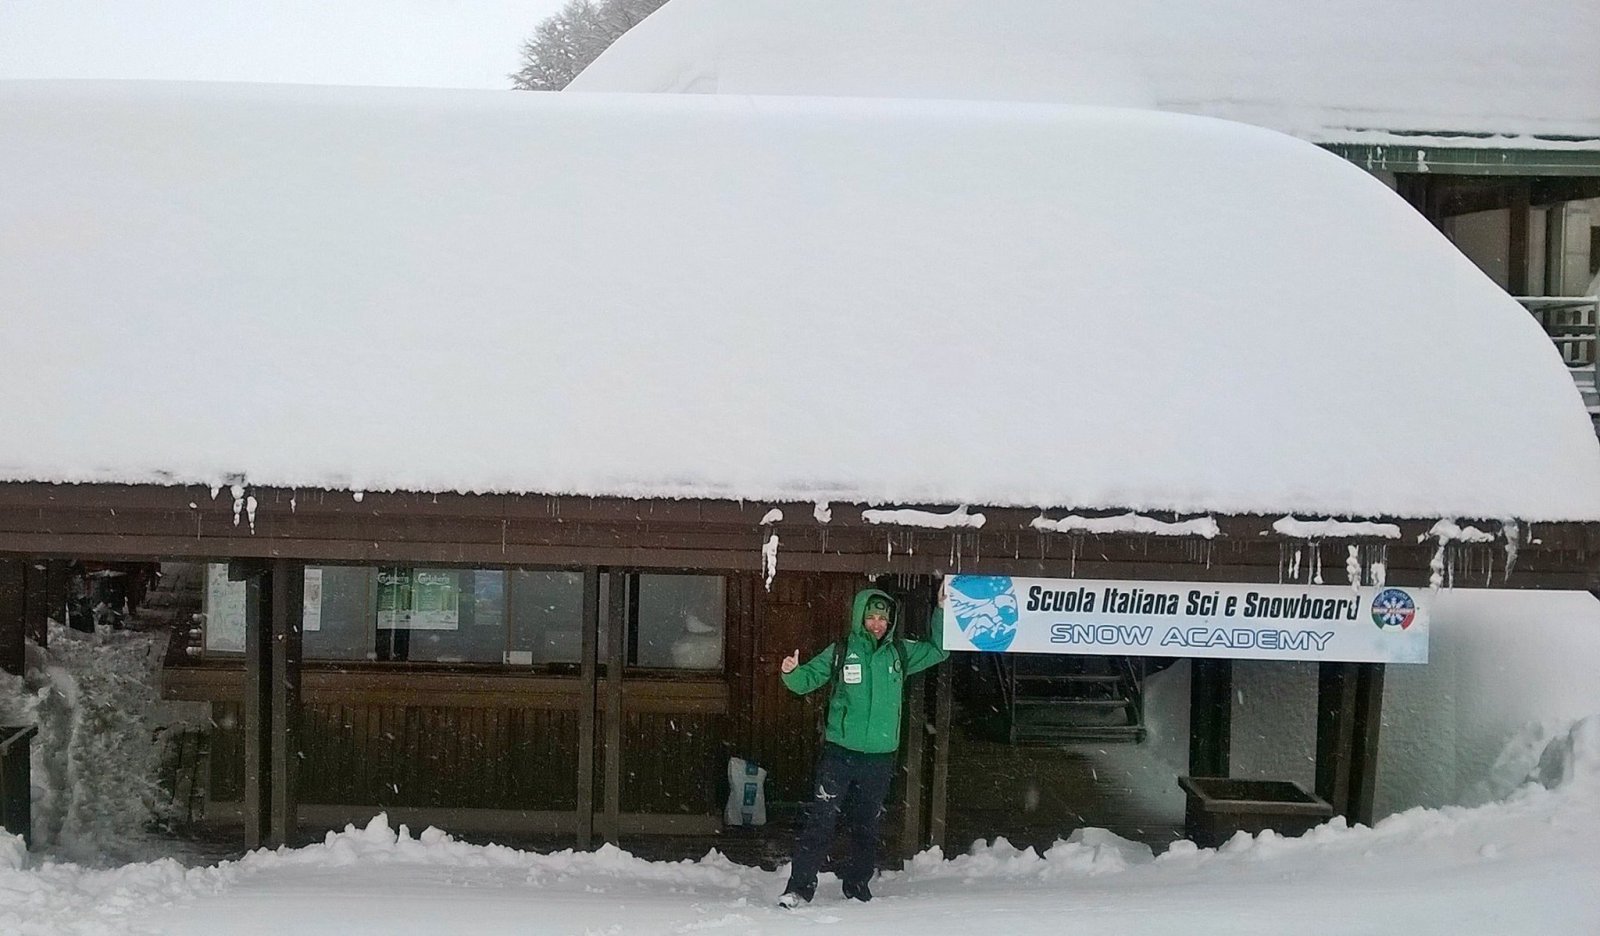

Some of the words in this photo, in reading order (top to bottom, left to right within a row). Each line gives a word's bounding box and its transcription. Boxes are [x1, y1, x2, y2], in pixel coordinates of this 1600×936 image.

[418, 572, 450, 587] Carlsberg
[1026, 586, 1096, 613] Scuola
[1101, 588, 1180, 615] Italiana
[1185, 590, 1219, 616] Sci
[1224, 596, 1237, 617] e
[1243, 592, 1360, 621] Snowboard
[1050, 623, 1153, 646] SNOW
[1160, 626, 1335, 651] ACADEMY
